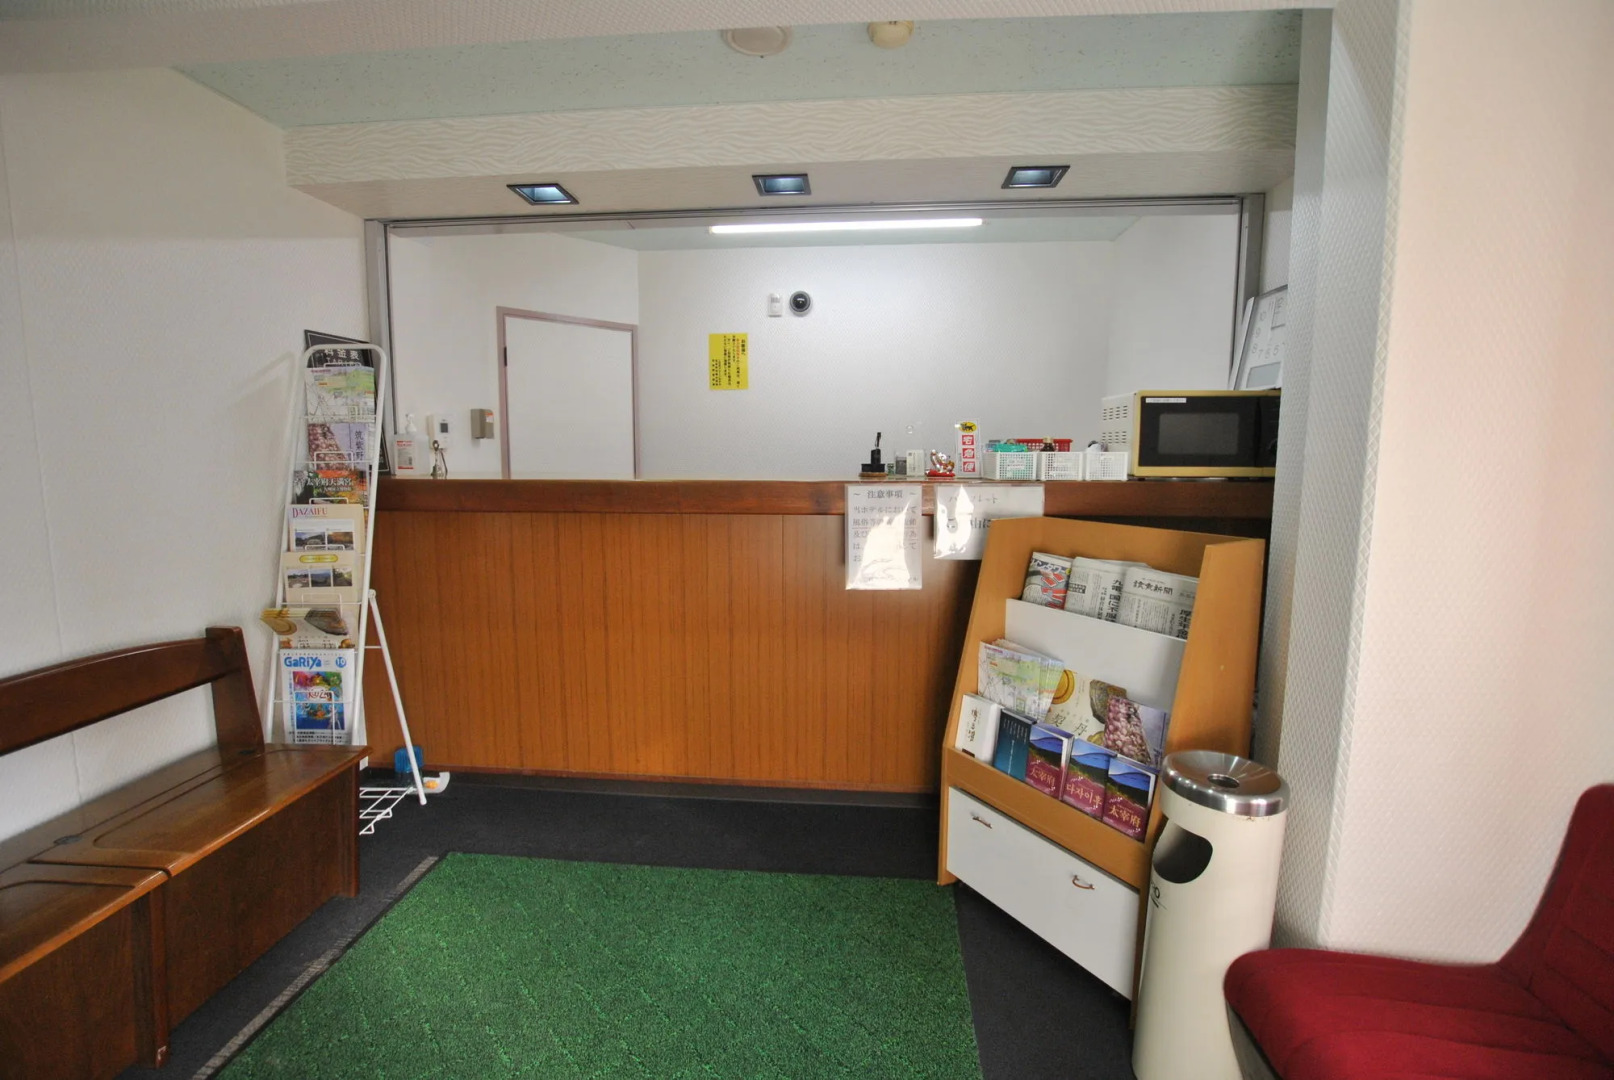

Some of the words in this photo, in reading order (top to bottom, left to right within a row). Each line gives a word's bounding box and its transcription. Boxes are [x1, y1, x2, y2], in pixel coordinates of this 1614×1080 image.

[962, 435, 976, 472] 宅急便
[867, 489, 903, 499] 注意事項
[292, 508, 328, 518] DAZAIFU
[284, 657, 322, 669] GaRiYa
[1066, 783, 1102, 806] 다자이후
[1109, 805, 1141, 827] 太宰府
